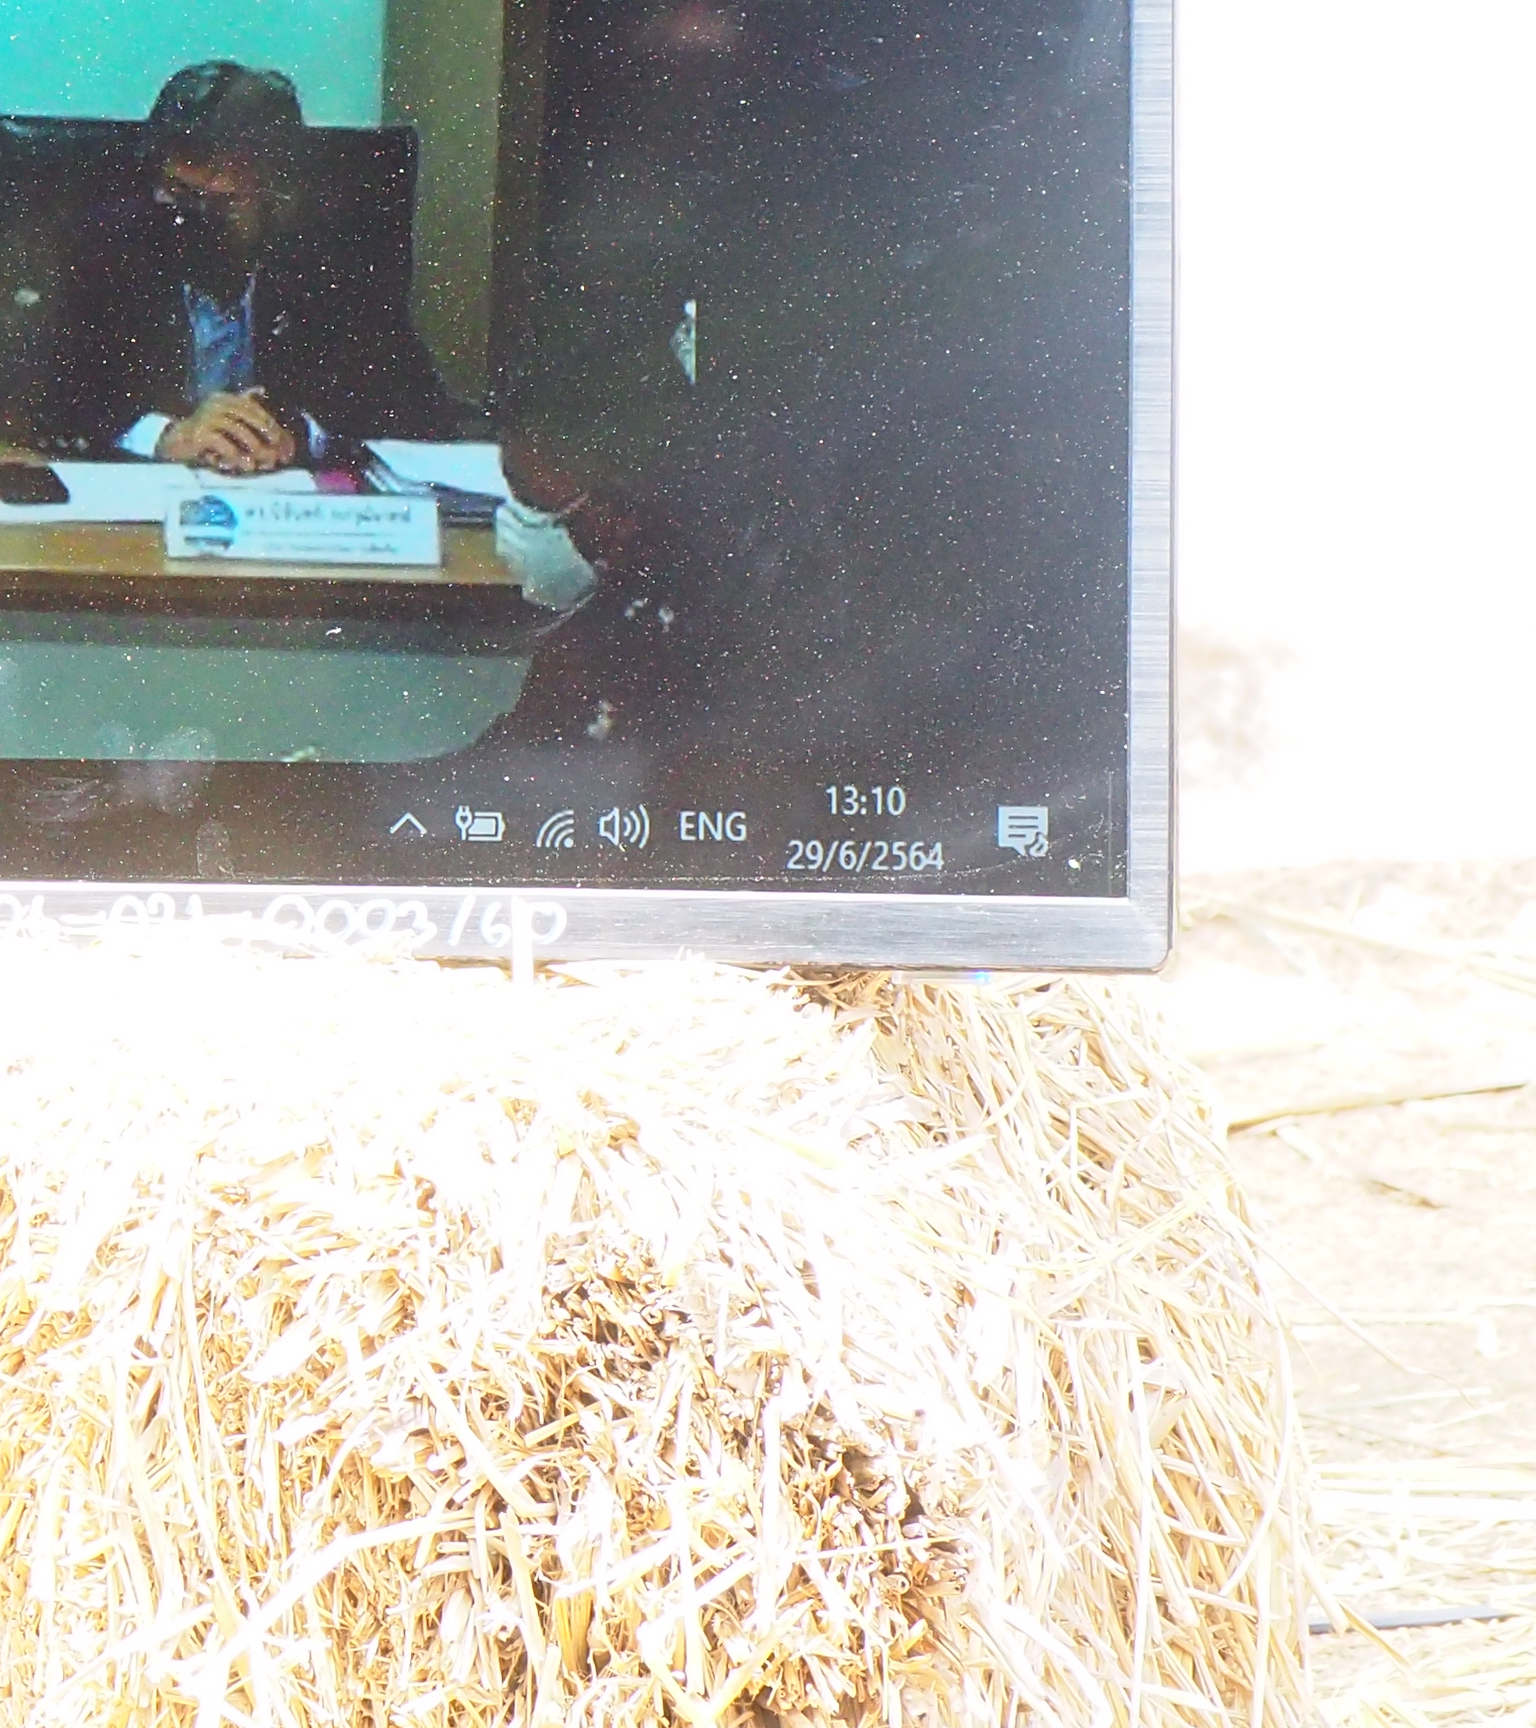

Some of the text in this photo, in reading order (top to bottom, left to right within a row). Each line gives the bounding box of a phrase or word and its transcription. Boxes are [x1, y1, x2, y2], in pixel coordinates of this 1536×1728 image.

[825, 784, 907, 816] 13:10
[679, 810, 748, 842] ENG
[786, 839, 945, 873] 29/6/2564
